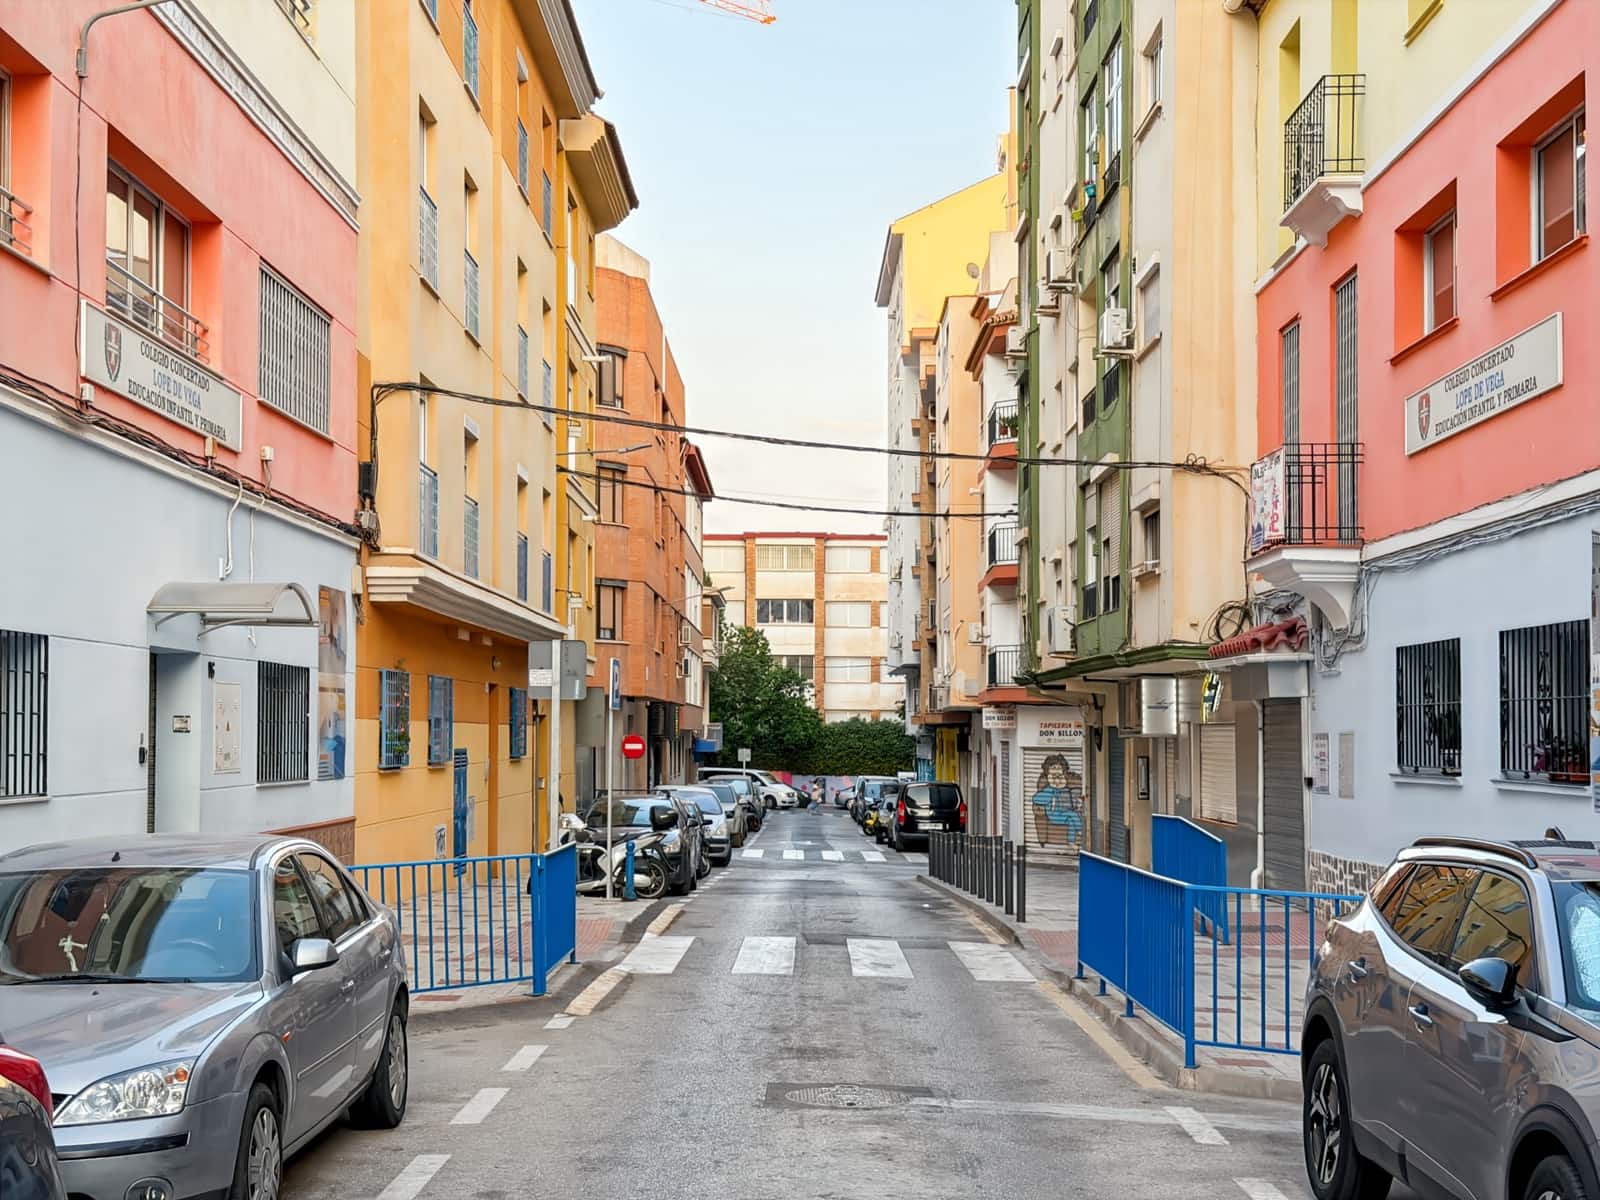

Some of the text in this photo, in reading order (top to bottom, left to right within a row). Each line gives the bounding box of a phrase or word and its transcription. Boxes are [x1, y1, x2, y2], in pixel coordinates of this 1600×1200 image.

[140, 341, 210, 392] COLEGIO CONCERTADO
[153, 369, 202, 411] LOPE DE VEGA
[1444, 343, 1515, 392] COLEGIO CONCERTADO
[1455, 369, 1505, 410] LOPE DE VEGA
[128, 378, 227, 441] EDUCACIÓN INFANTIL Y PRIMARIA
[1435, 375, 1538, 436] EDUCACIÓN INFANTIL Y PRIMARIA
